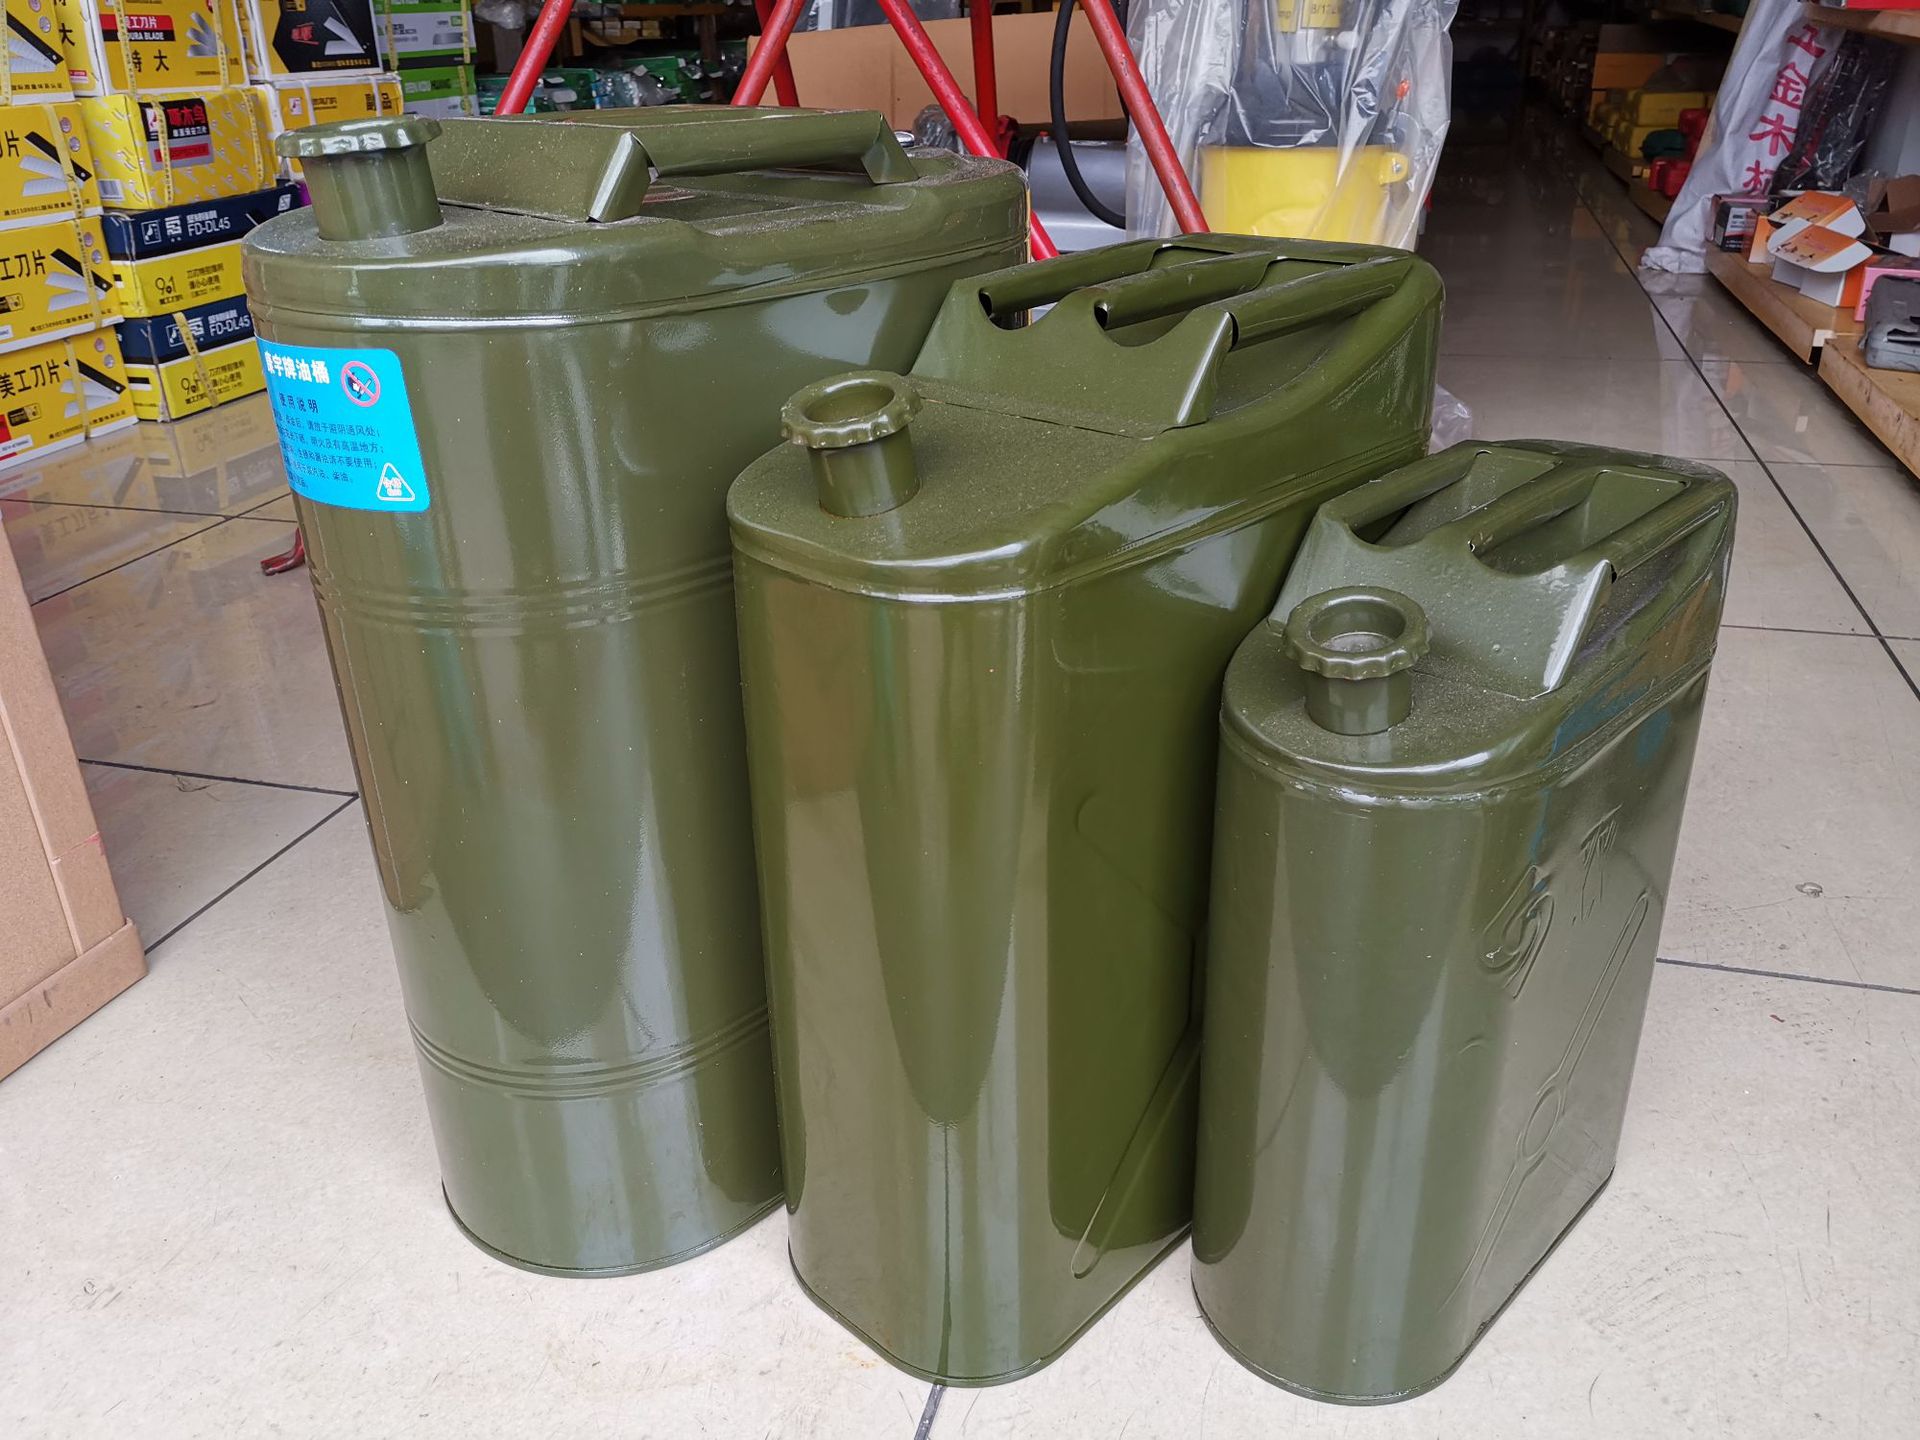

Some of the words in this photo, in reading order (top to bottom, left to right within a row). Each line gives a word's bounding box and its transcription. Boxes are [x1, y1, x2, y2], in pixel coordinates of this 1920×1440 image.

[144, 31, 165, 41] BLADE
[187, 216, 232, 238] FD-DL45
[208, 314, 251, 338] FD-DL45
